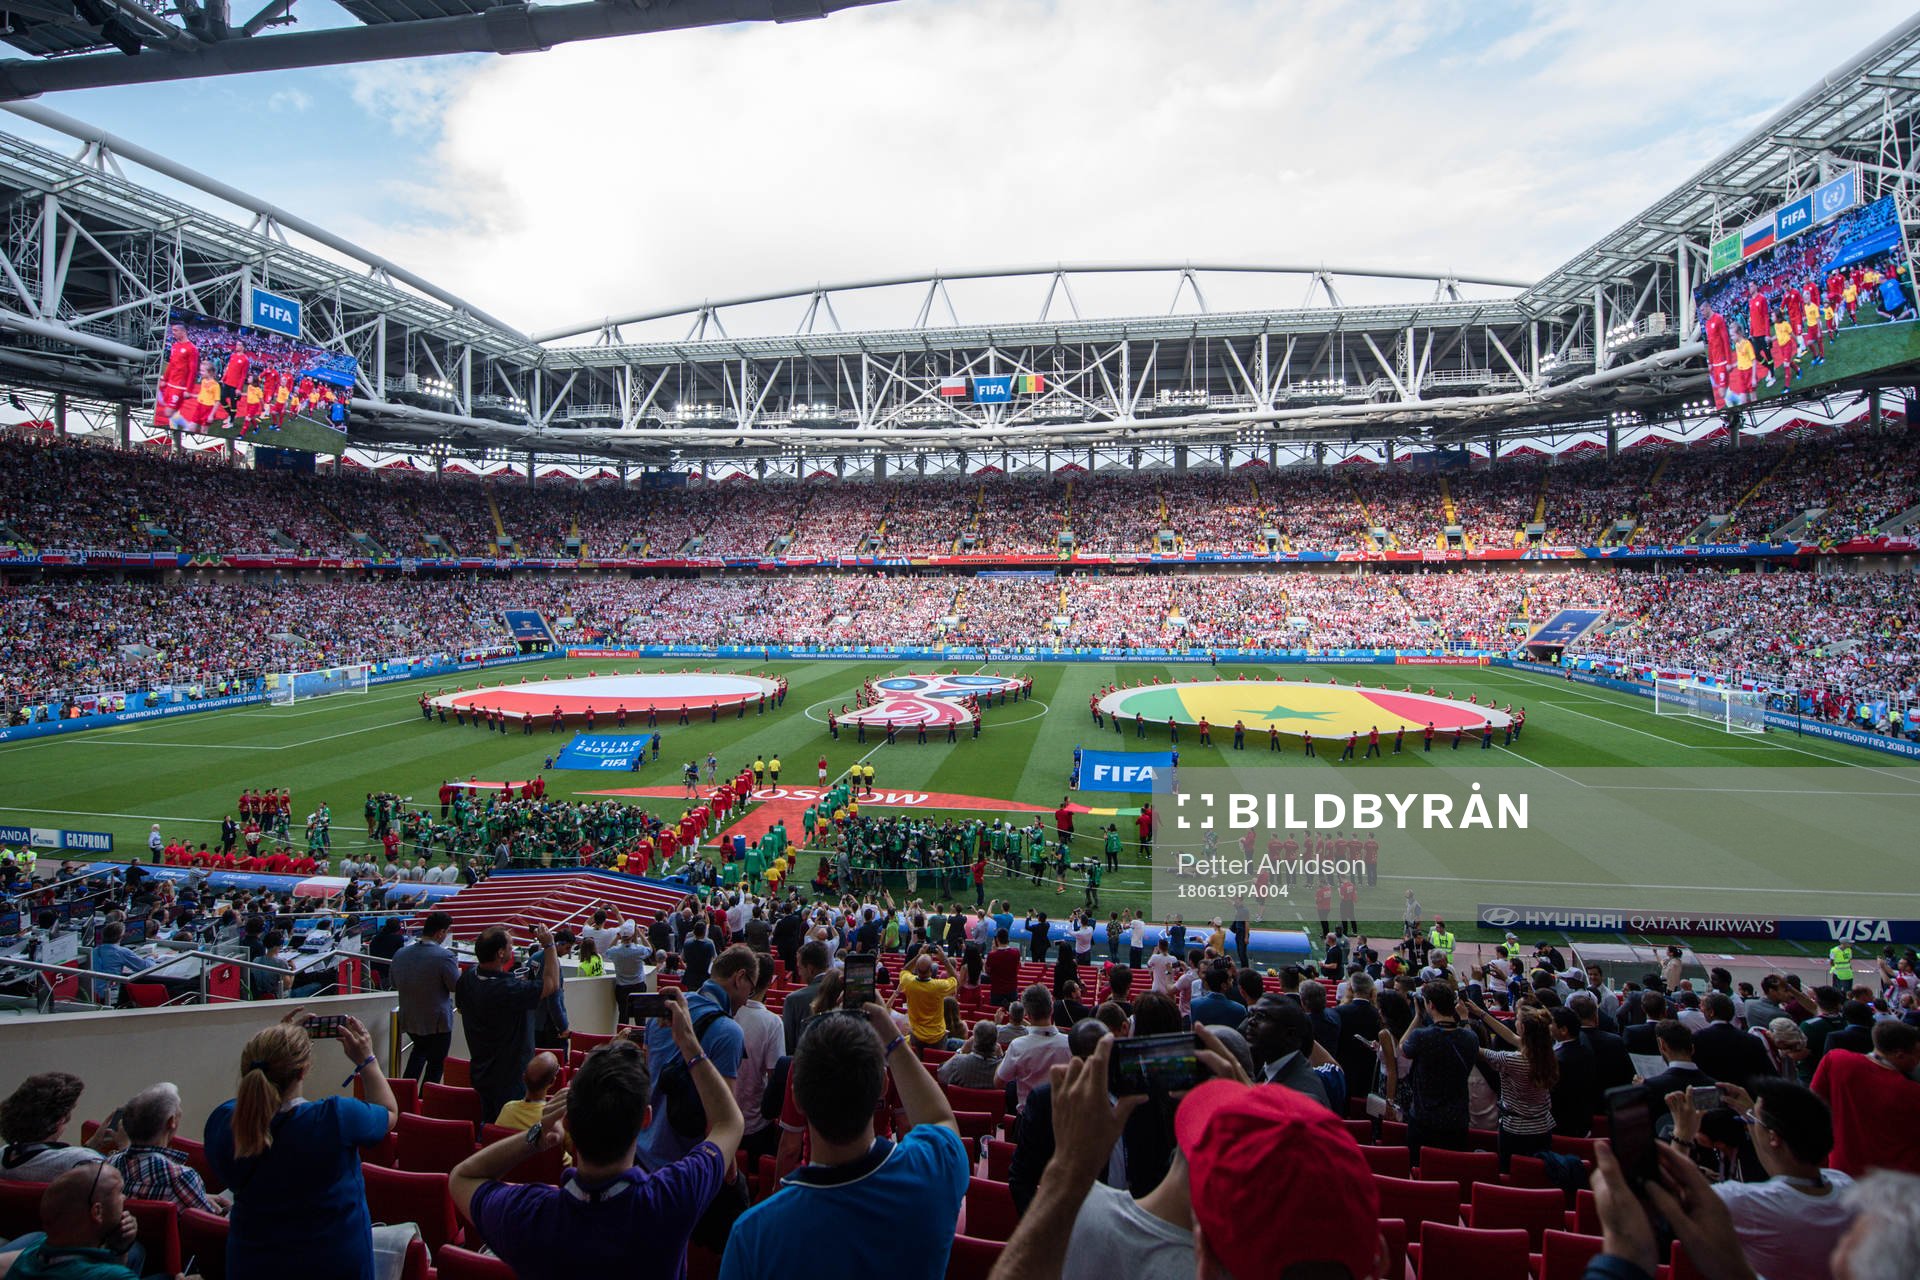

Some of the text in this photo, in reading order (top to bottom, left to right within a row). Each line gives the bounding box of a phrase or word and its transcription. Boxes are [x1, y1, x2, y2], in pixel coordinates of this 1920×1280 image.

[1781, 208, 1807, 229] FIFA
[260, 302, 293, 324] FIFA
[979, 385, 1006, 396] FIFA
[1801, 722, 1822, 733] МИРА
[1822, 727, 1832, 736] ПО
[1833, 730, 1868, 744] ФУТБОЛУ
[1868, 737, 1886, 748] FIFA
[1887, 741, 1906, 752] 2018
[576, 745, 635, 754] FOOTBALL
[600, 759, 627, 767] FIFA
[1094, 765, 1158, 782] FIFA
[0, 829, 29, 842] ANDA
[66, 832, 110, 849] GAZPROM
[1525, 911, 1623, 929] HYUNDAI
[1630, 915, 1774, 934] QATAR AIRWAYS
[1822, 918, 1892, 942] VISA
